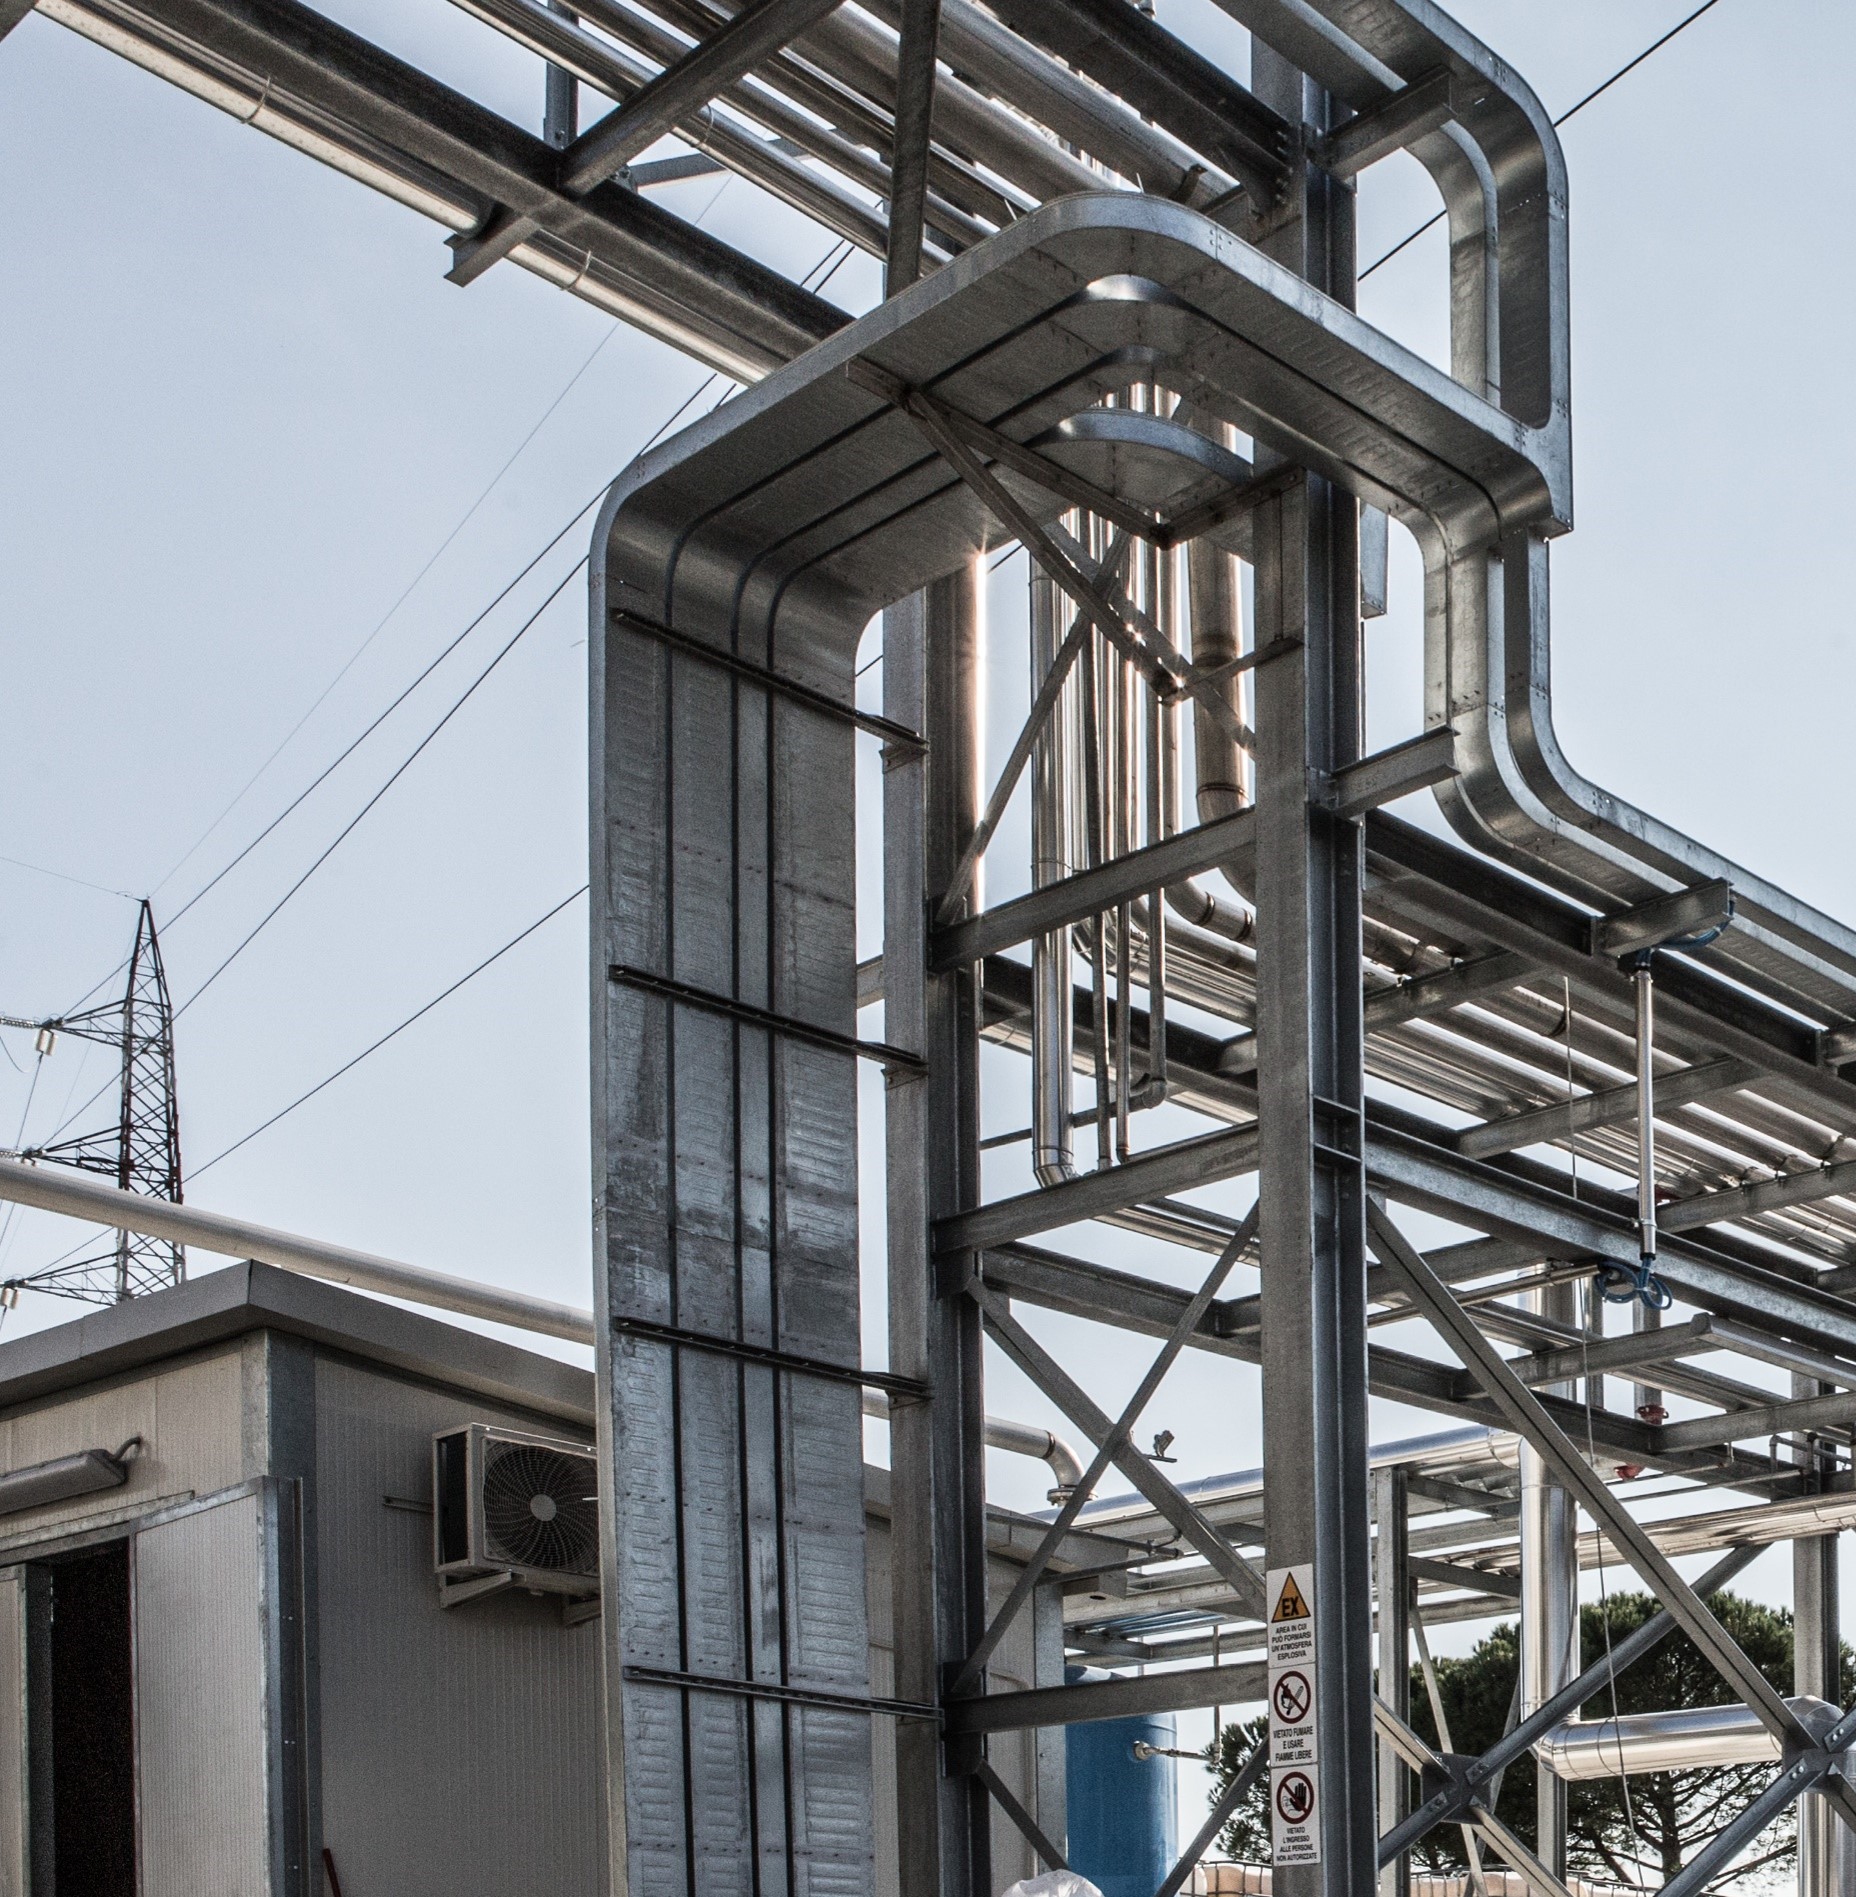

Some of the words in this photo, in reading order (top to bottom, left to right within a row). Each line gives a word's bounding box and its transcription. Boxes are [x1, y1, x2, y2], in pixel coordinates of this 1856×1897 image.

[1282, 1597, 1300, 1616] EX
[1284, 1632, 1312, 1641] FORMARSI
[1272, 1640, 1312, 1652] UN'ATMOSFERA
[1278, 1650, 1306, 1660] ESPLOSIVA
[1273, 1729, 1292, 1738] VIETATO
[1294, 1726, 1314, 1736] FUMARE
[1283, 1741, 1286, 1749] E
[1288, 1739, 1304, 1749] USARE
[1276, 1752, 1294, 1762] FIAMME
[1295, 1750, 1312, 1760] LIBERE
[1282, 1835, 1310, 1844] L'INGRESSO
[1292, 1844, 1314, 1852] PERSONE
[1287, 1852, 1317, 1860] AUTORIZZATE
